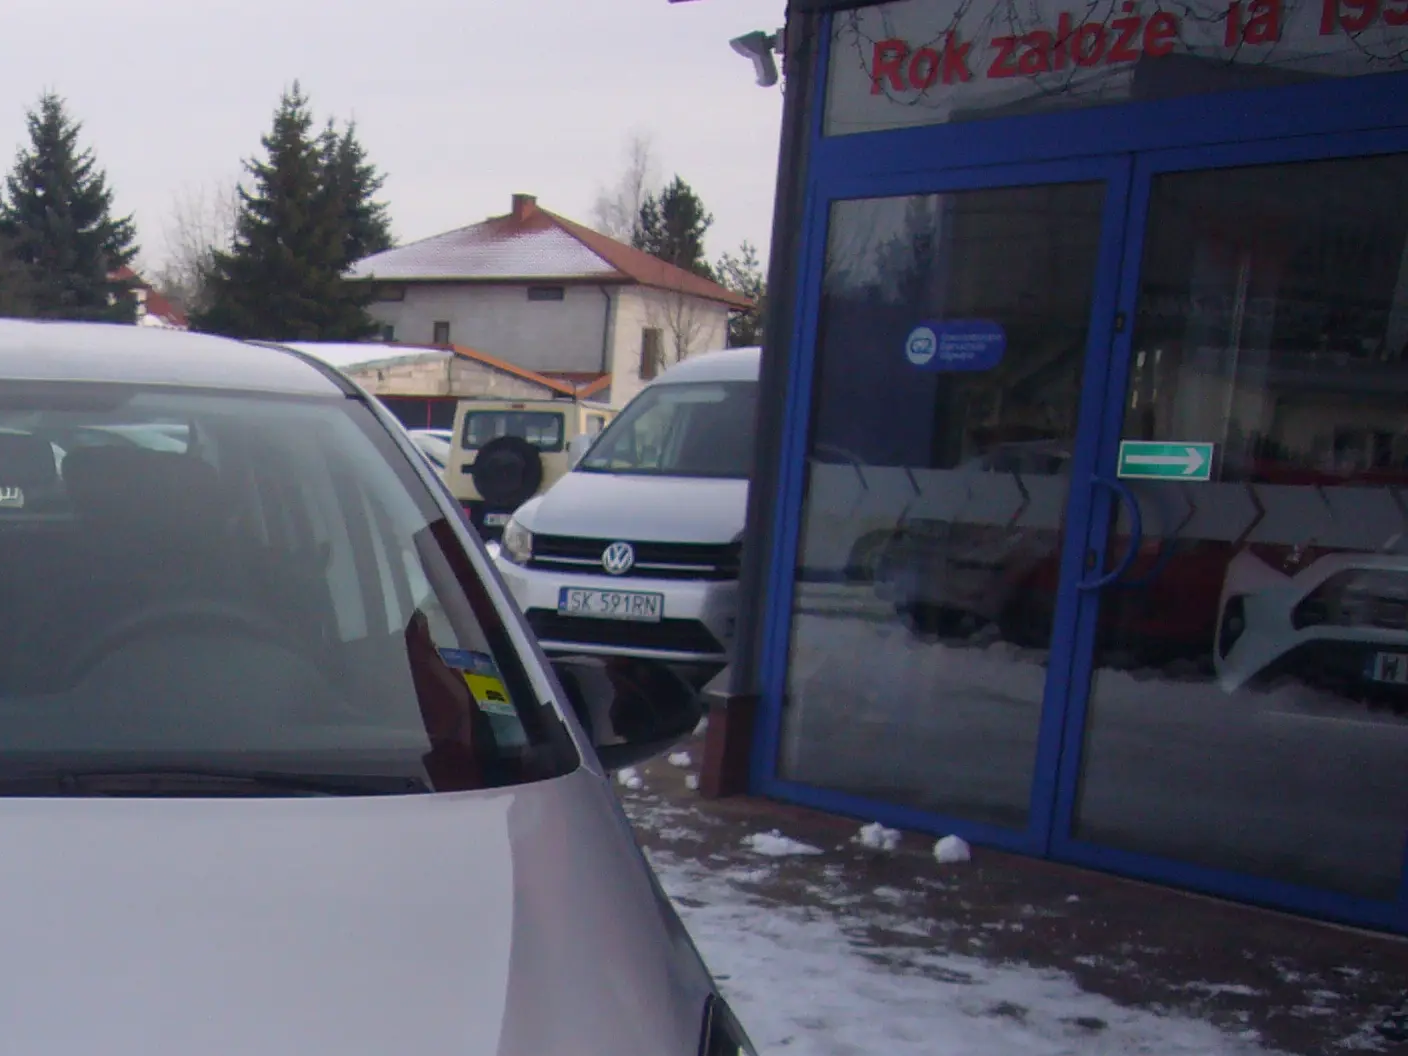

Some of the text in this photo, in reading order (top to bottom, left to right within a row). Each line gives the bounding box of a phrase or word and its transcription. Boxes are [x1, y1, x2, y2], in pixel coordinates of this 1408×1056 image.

[870, 30, 972, 95] Rok
[571, 592, 657, 616] SK 591RN
